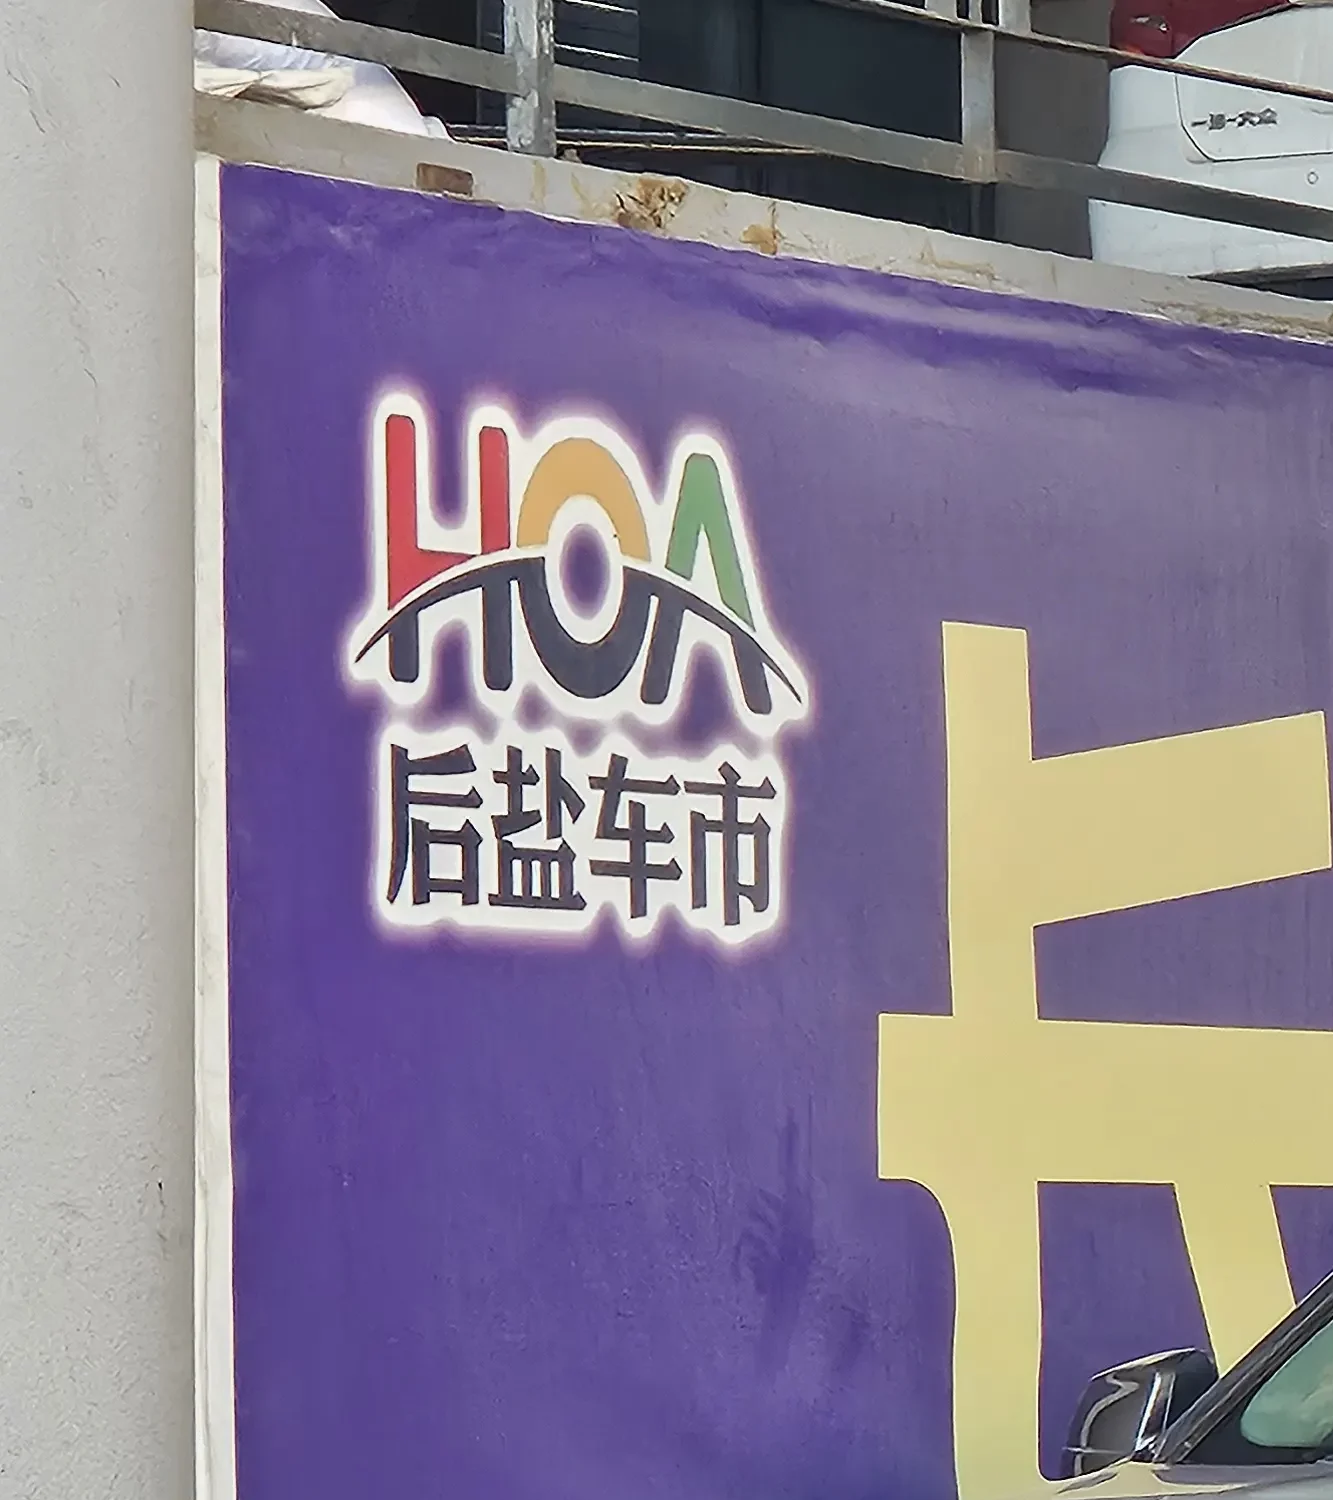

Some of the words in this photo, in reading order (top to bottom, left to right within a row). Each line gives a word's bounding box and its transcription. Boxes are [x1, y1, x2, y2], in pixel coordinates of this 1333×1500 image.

[356, 412, 803, 716] HOA
[386, 743, 777, 926] 后盐车市
